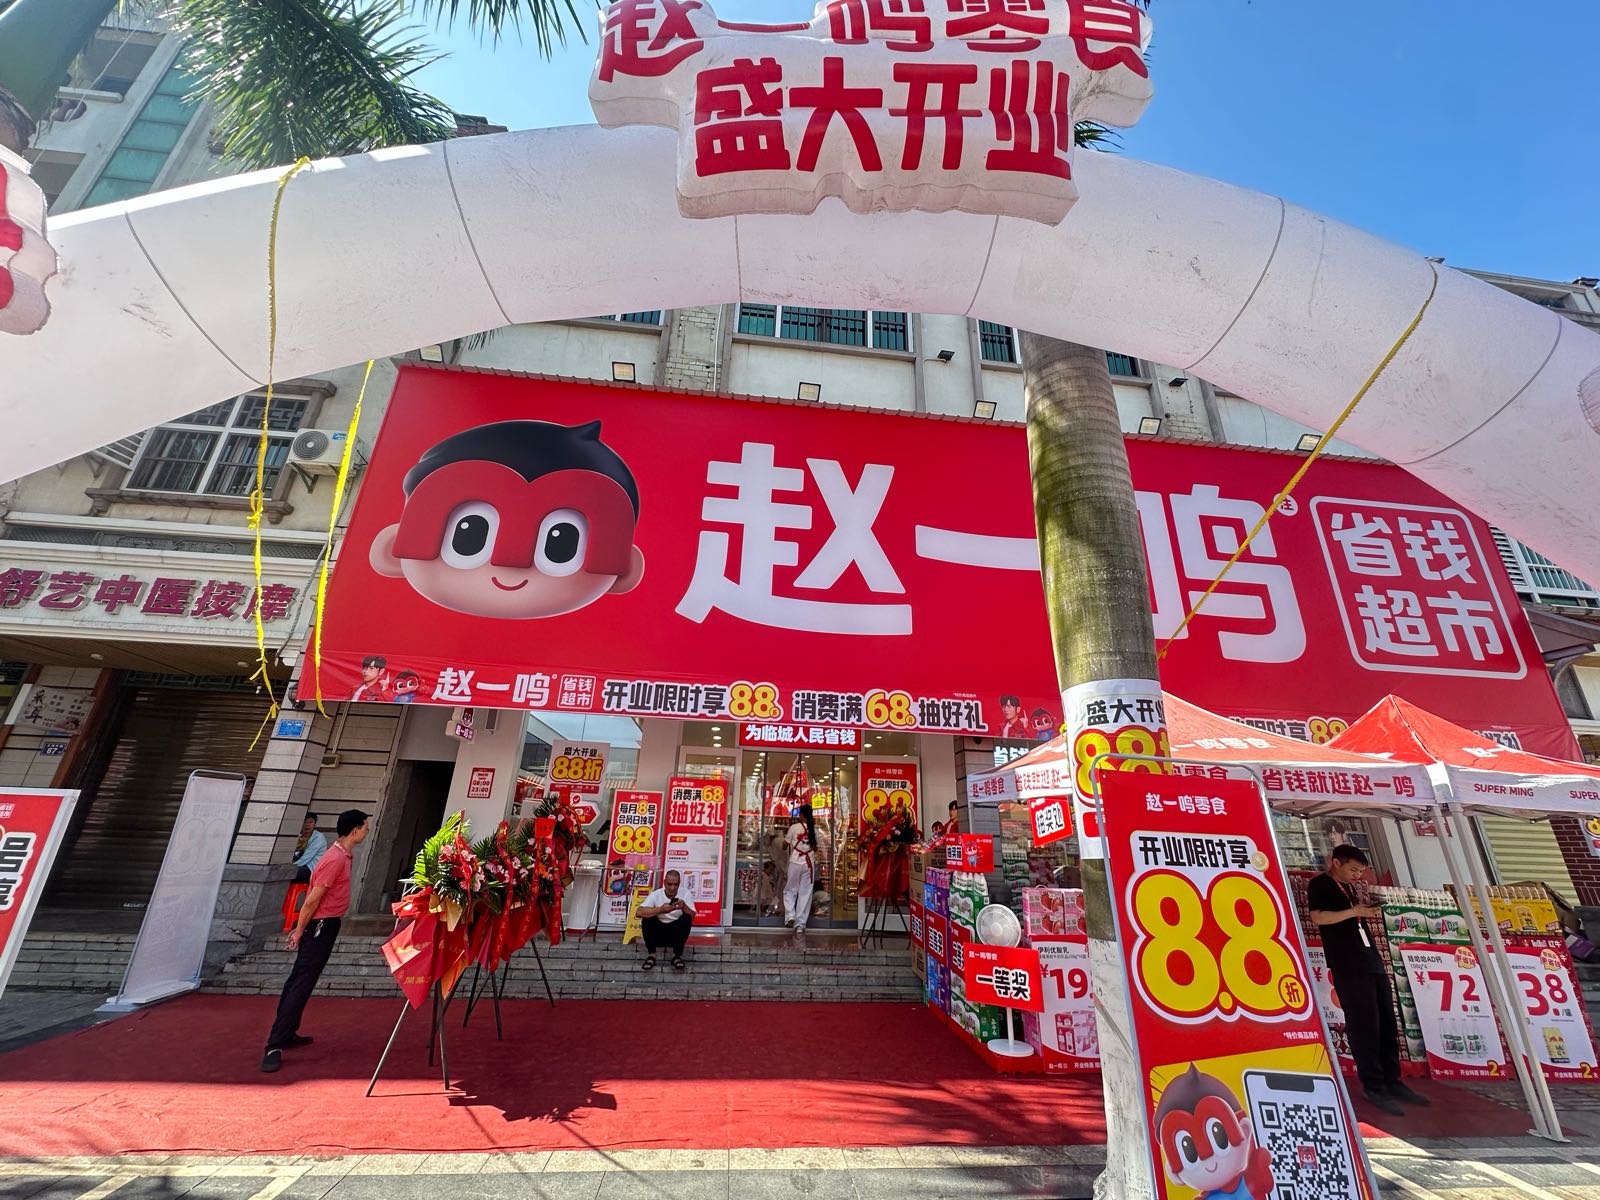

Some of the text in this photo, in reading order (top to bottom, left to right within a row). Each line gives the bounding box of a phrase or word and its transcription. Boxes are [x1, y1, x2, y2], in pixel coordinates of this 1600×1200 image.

[695, 56, 1072, 180] 盛大开业
[1330, 511, 1477, 585] 省钱
[0, 567, 298, 622] 舒艺中医按摩
[1355, 585, 1504, 661] 超市
[431, 667, 550, 707] 赵一鸣
[563, 675, 593, 692] 省钱
[560, 692, 592, 706] 超市
[745, 725, 856, 746] 为临城人民省钱
[46, 747, 58, 755] 67
[564, 747, 597, 757] 盛大开业
[673, 786, 724, 802] 消费满68
[1262, 768, 1416, 798] 省钱就逛赵一鸣
[1474, 783, 1600, 801] SUPER MING SUPER
[620, 800, 656, 815] 每月8号
[671, 801, 722, 825] 抽好礼
[1146, 793, 1228, 816] 赵一鸣零食
[1138, 836, 1252, 869] 开业限时享
[978, 969, 1029, 998] 一等奖
